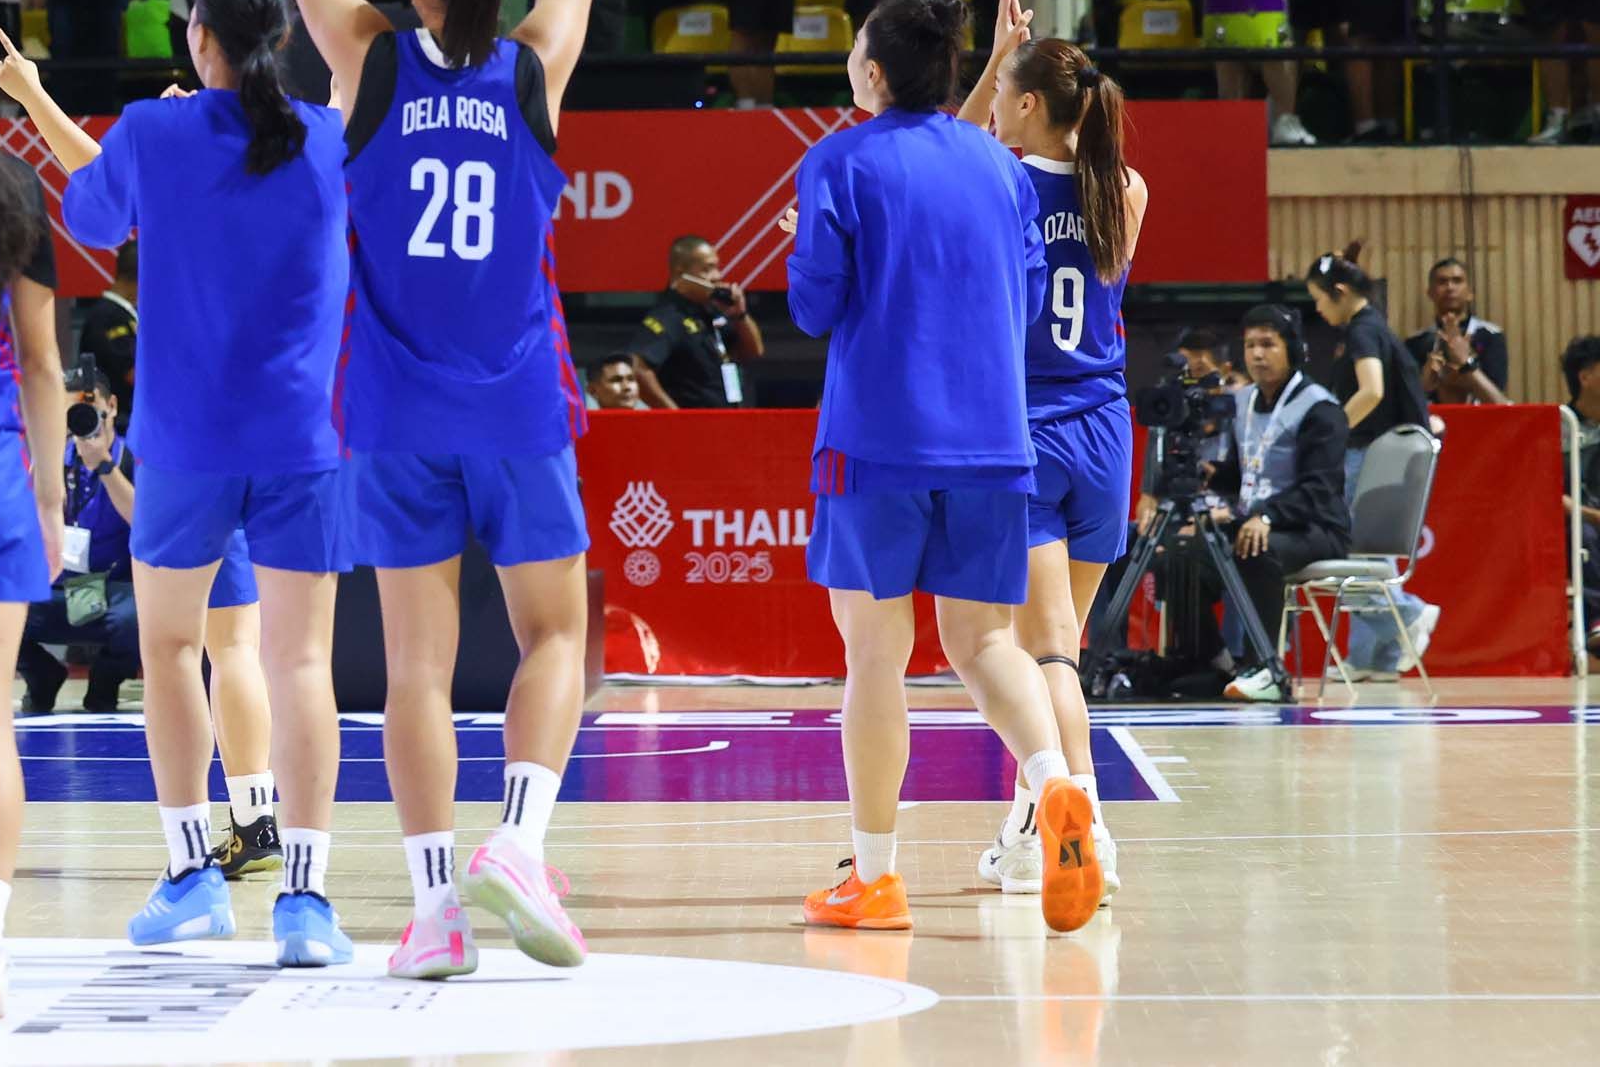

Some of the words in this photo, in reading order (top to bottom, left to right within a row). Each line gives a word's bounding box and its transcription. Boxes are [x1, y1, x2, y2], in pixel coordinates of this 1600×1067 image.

[402, 95, 450, 136] DELA
[455, 96, 507, 141] ROSA
[407, 157, 496, 261] 28
[1044, 211, 1089, 246] OZAR
[1051, 266, 1085, 352] 9
[682, 508, 811, 547] THAIL
[684, 551, 774, 583] 2025
